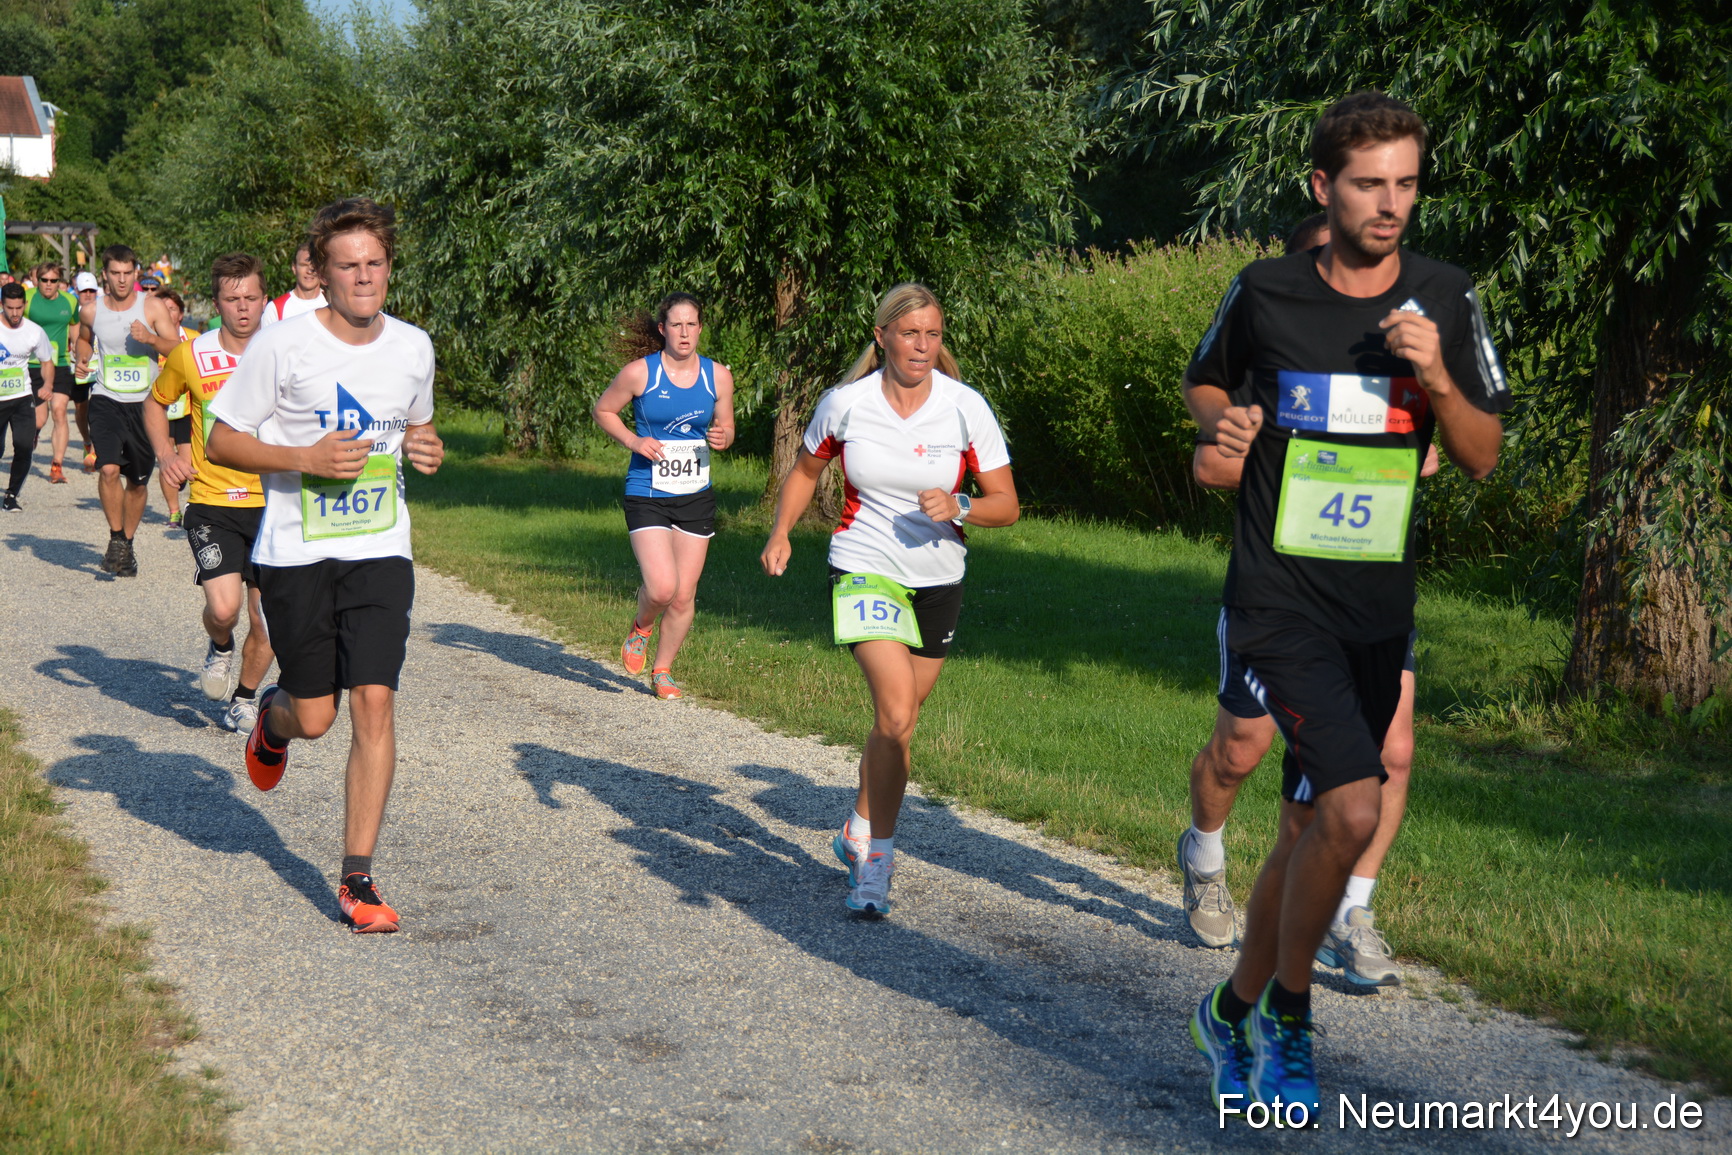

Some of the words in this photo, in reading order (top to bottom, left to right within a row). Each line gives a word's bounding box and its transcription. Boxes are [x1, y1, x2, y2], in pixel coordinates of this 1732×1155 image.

[114, 370, 140, 382] 350
[1279, 411, 1326, 423] PEUGEOT
[658, 458, 701, 477] 8941
[313, 487, 388, 517] 1467
[1318, 492, 1373, 529] 45
[1310, 533, 1340, 543] Michael
[853, 599, 902, 624] 157
